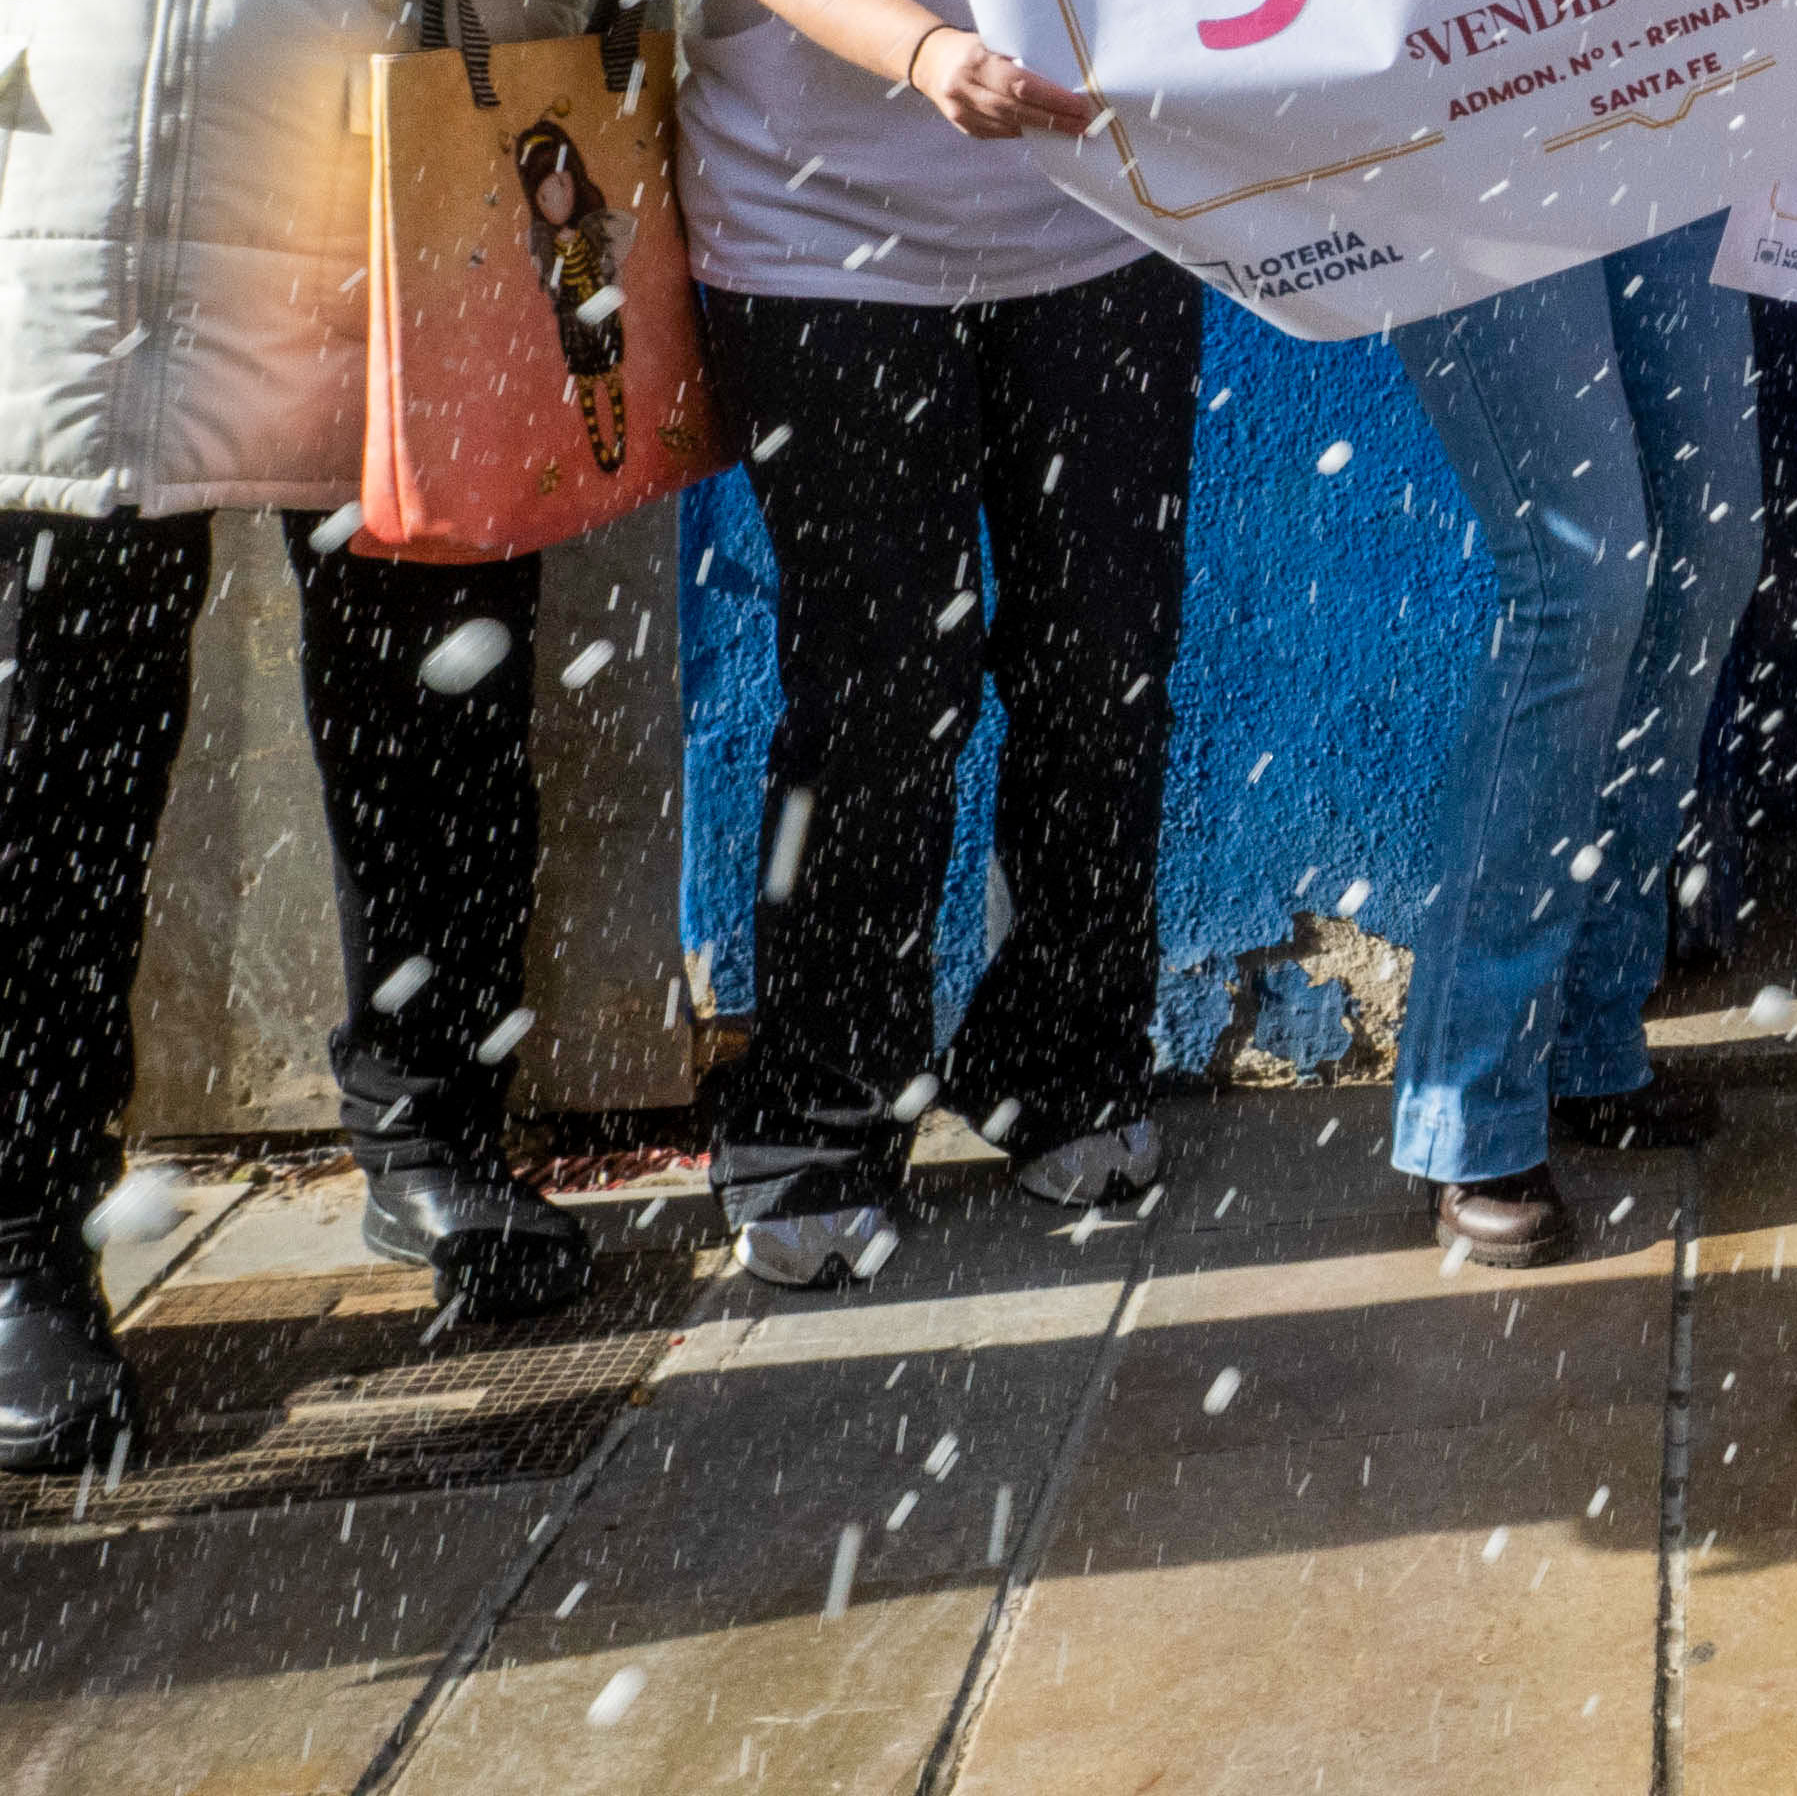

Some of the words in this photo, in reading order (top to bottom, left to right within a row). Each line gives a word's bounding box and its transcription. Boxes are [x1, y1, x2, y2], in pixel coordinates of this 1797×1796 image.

[1448, 64, 1567, 122] ADMON.
[1645, 1, 1731, 49] REINA
[1589, 69, 1685, 118] SANTA
[1687, 51, 1723, 82] FE
[1243, 230, 1366, 282] LOTERÍA
[1254, 244, 1404, 301] NACIONAL
